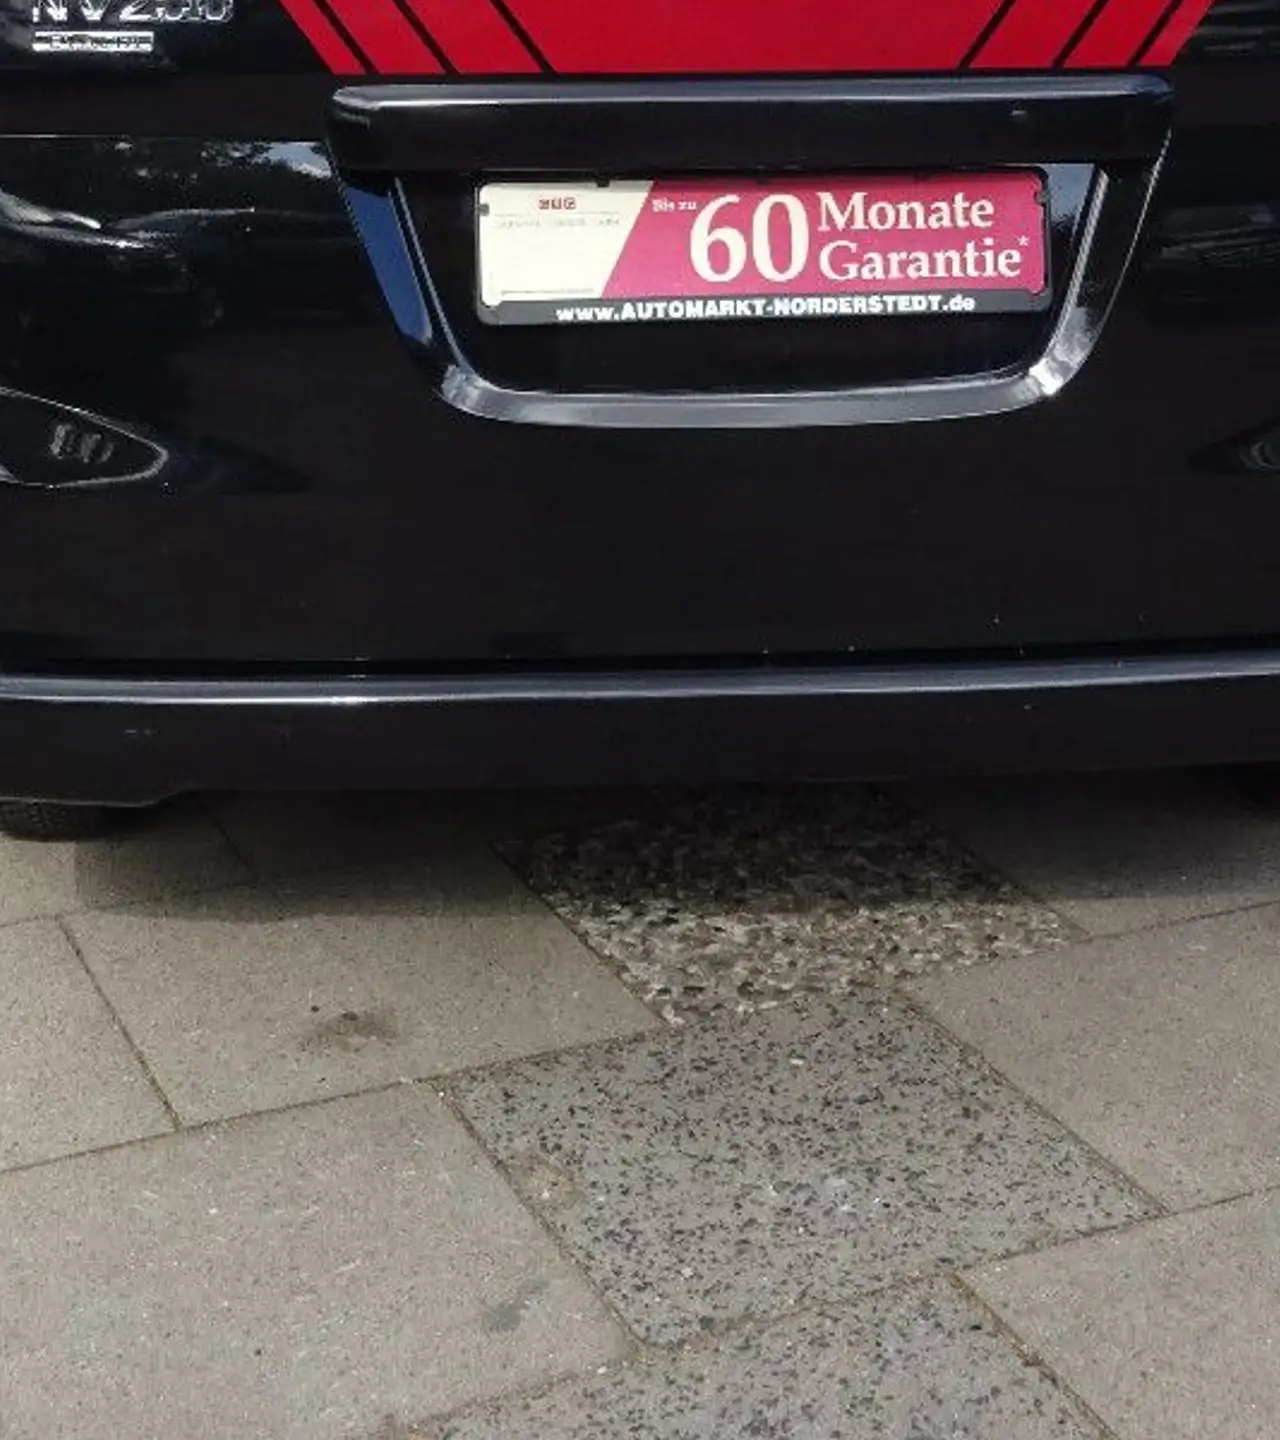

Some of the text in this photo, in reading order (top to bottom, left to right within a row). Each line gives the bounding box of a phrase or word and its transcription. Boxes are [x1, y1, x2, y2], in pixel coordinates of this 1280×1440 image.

[817, 191, 995, 233] Monate
[689, 193, 808, 283] 60
[556, 293, 976, 322] www.AUTOMARKT-NORDERSTEDT.de
